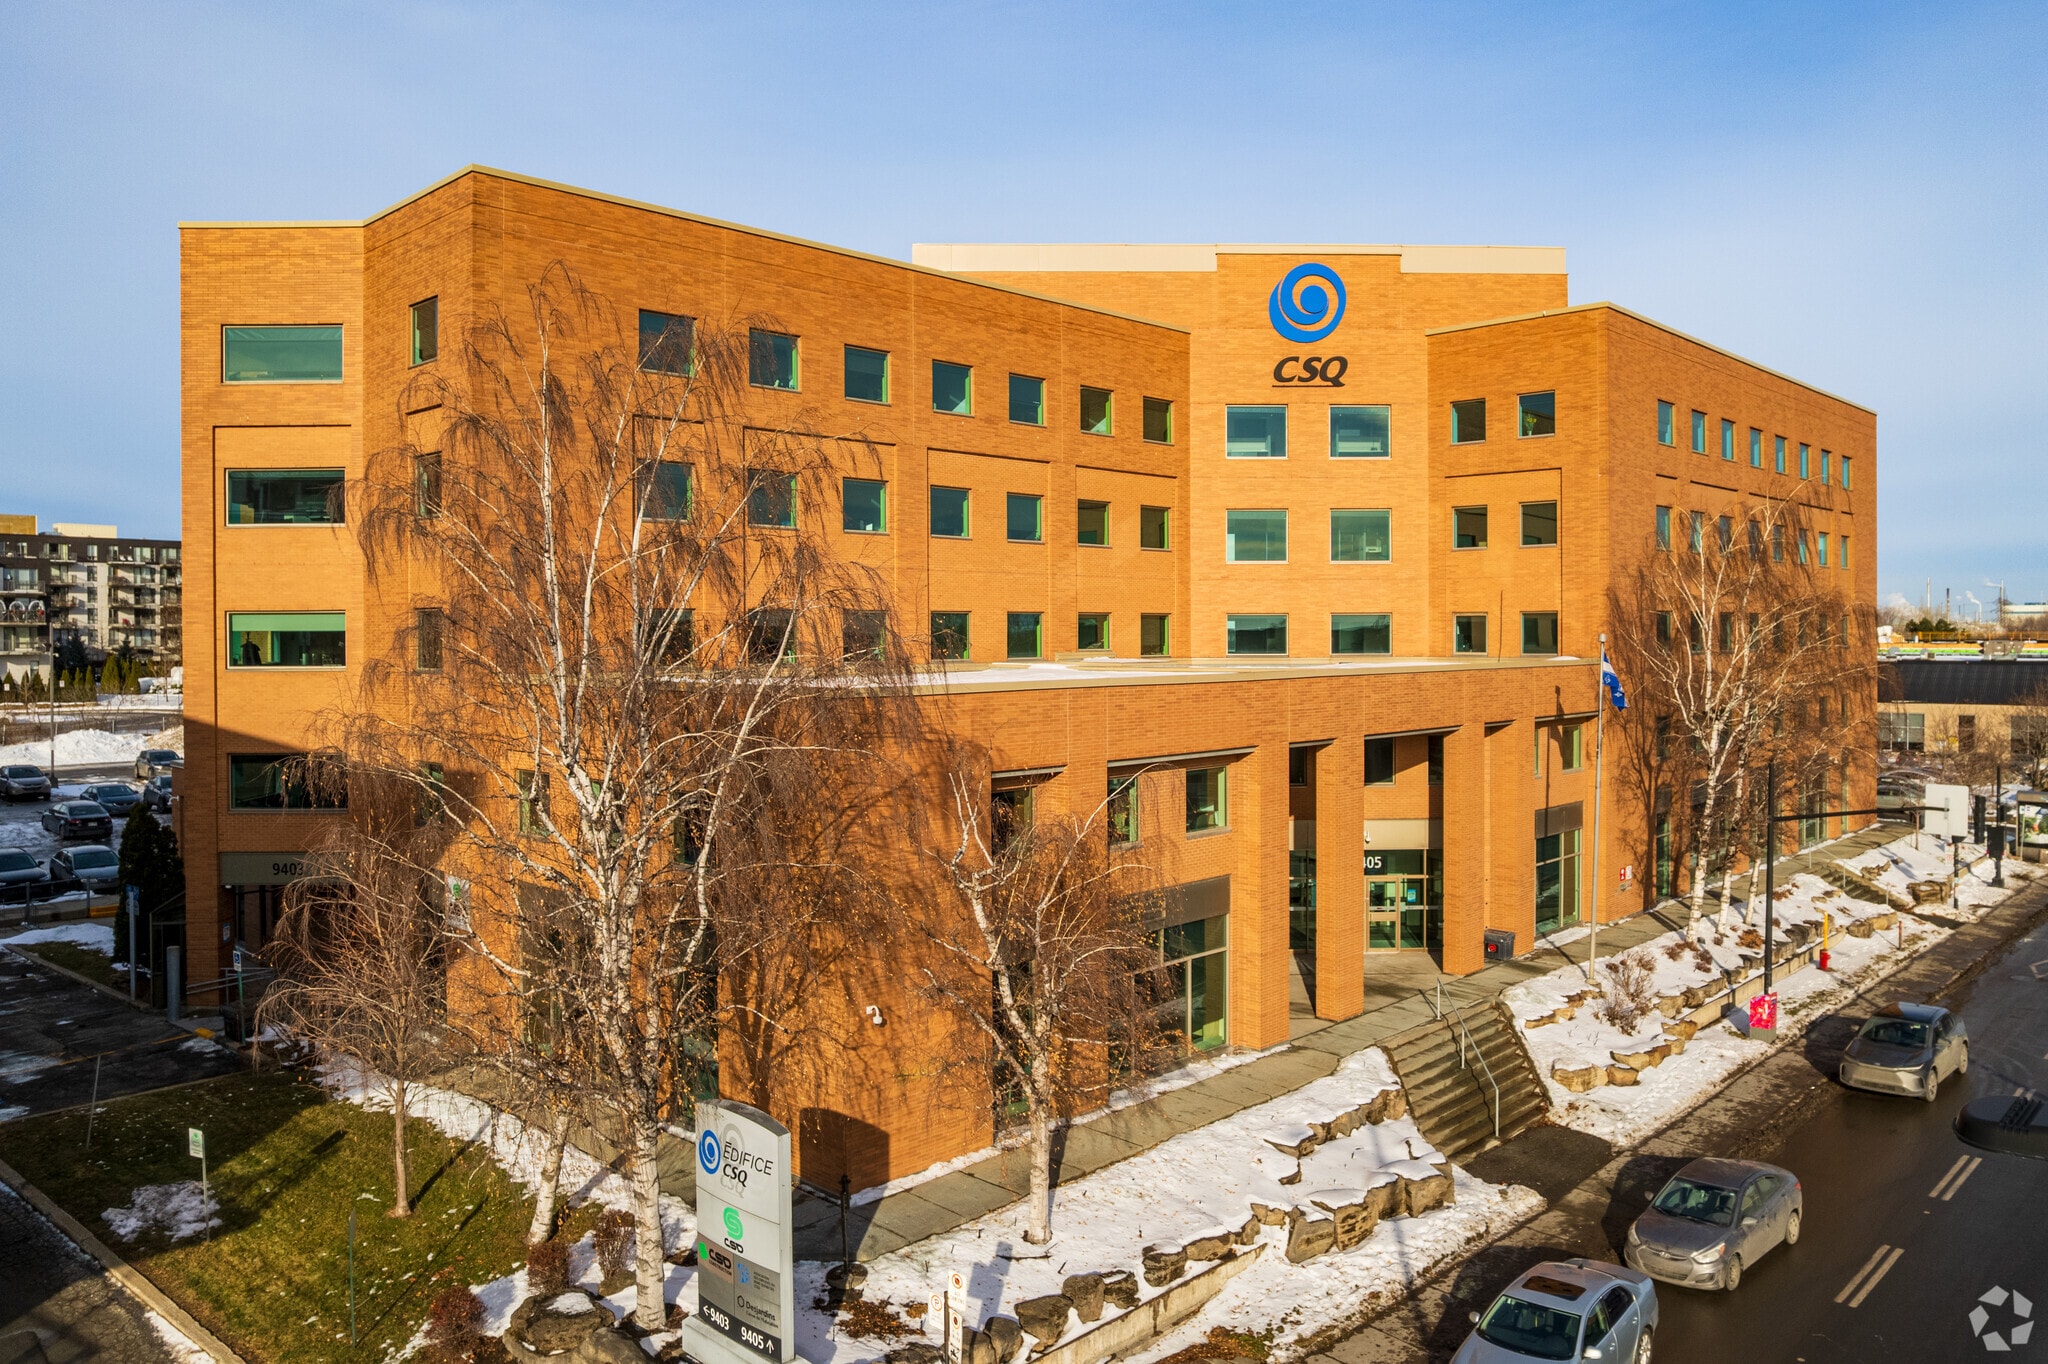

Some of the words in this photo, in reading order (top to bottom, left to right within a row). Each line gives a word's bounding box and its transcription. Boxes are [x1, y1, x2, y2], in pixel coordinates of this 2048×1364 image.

[1273, 355, 1348, 388] CSQ
[272, 863, 304, 876] 9403
[723, 1163, 748, 1188] CSQ
[724, 1237, 744, 1254] CSD
[708, 1248, 732, 1270] CSD
[746, 1301, 776, 1321] Desjardins
[710, 1307, 730, 1331] 9403
[741, 1326, 764, 1349] 9405
